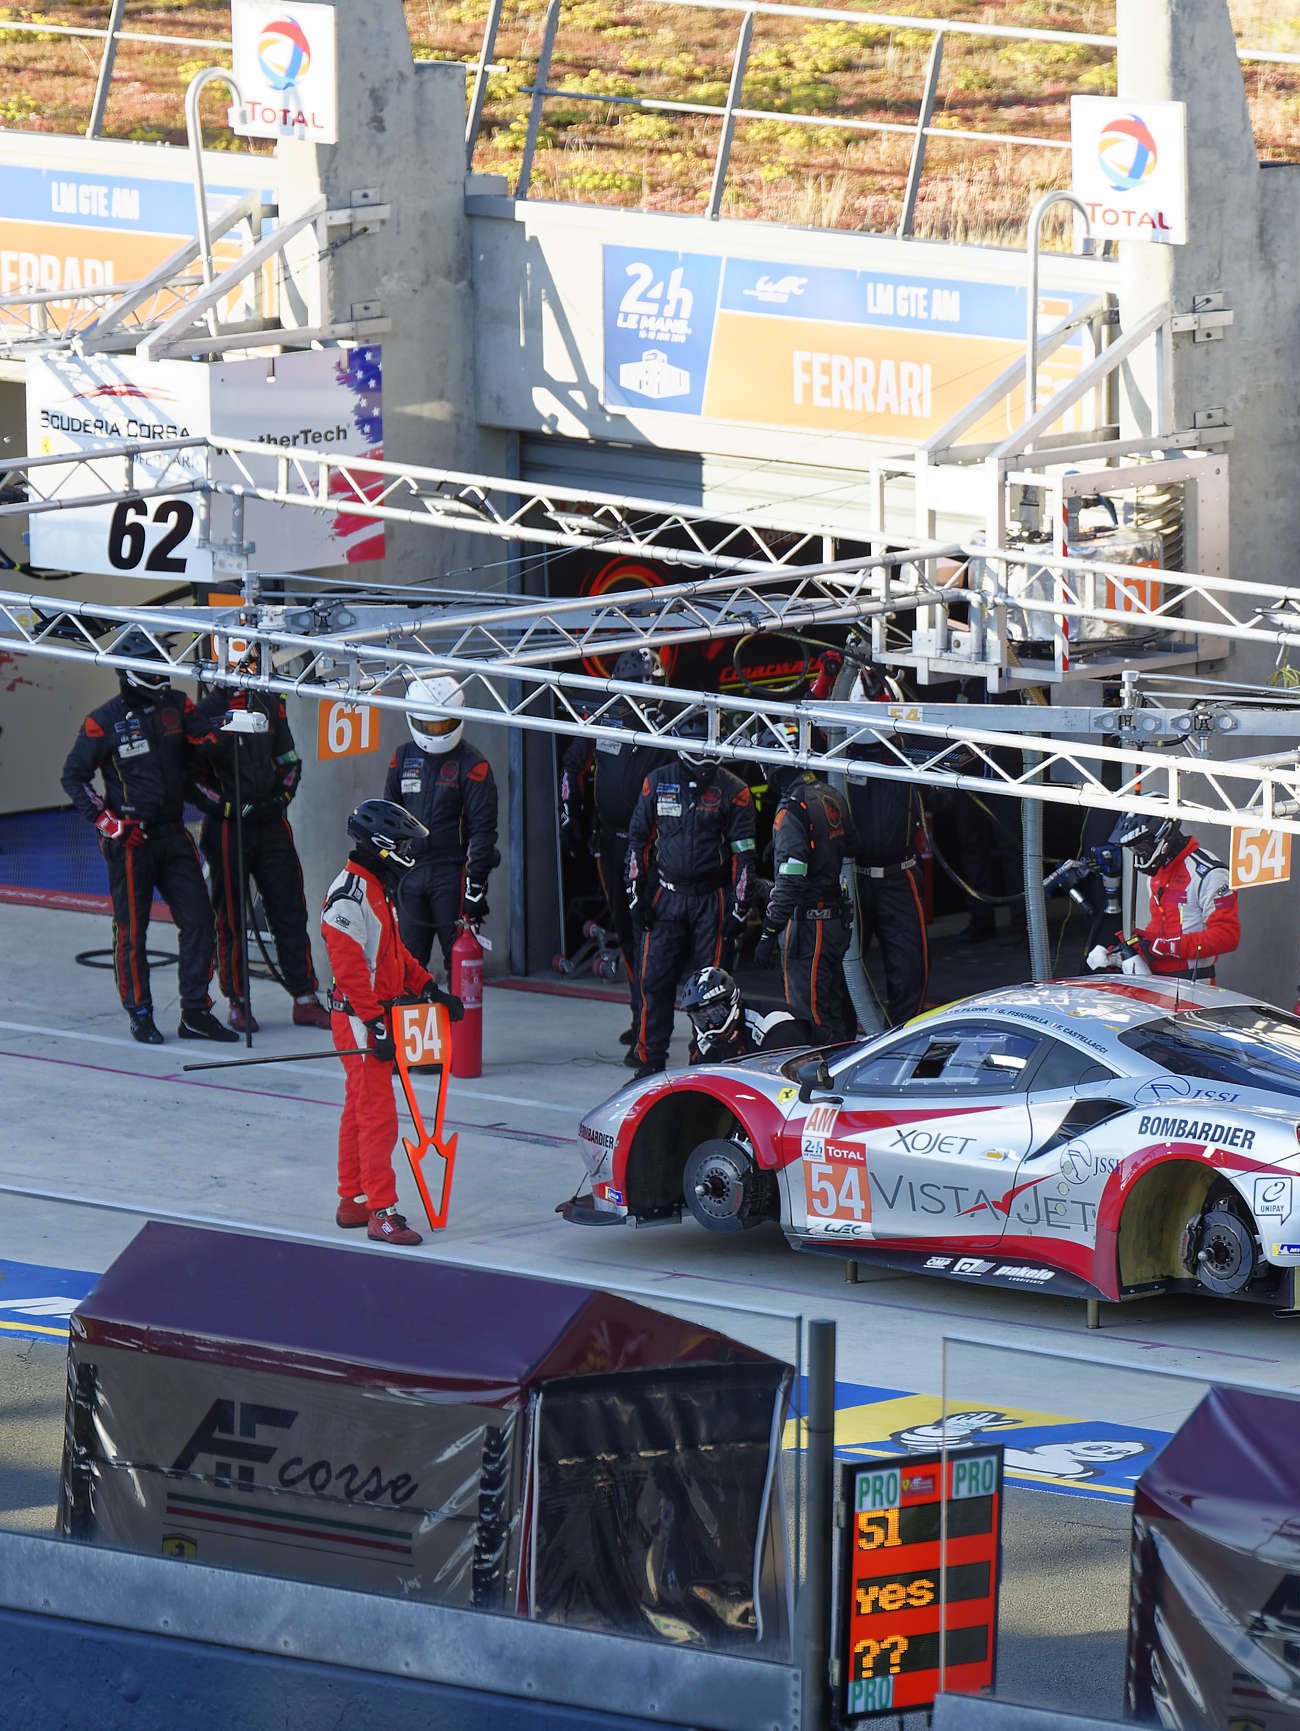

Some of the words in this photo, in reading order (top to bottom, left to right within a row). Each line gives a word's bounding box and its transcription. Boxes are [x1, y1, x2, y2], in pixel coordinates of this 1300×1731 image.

[244, 100, 324, 129] TOTAL
[1084, 202, 1173, 230] TOTAL
[867, 281, 894, 315] LM
[896, 284, 928, 320] GTE
[931, 288, 961, 322] AM
[793, 349, 932, 419] FERRARI
[40, 409, 121, 438] SCUDERIA
[126, 418, 191, 440] CORSA
[108, 499, 194, 573] 62
[327, 700, 370, 754] 61
[1120, 824, 1149, 844] BELL
[1236, 827, 1287, 883] 54
[702, 984, 727, 1000] BELL
[1007, 1010, 1049, 1026] FISICHELLA
[402, 1006, 442, 1063] 54
[1062, 1027, 1109, 1054] CASTELLACCI
[1192, 1088, 1241, 1104] JSSI
[804, 1106, 837, 1133] AM
[1138, 1115, 1256, 1150] BOMBARDIER
[826, 1145, 865, 1161] TOTAL
[889, 1129, 978, 1156] XOJET
[1093, 1156, 1121, 1177] JSSI
[811, 1163, 866, 1220] 54
[1260, 1205, 1284, 1213] UNIPAY
[823, 1223, 862, 1236] WEC
[277, 1456, 420, 1506] corse
[857, 1471, 899, 1511] PRO
[953, 1458, 995, 1498] PRO
[857, 1508, 903, 1551] 51
[854, 1634, 909, 1679] ??
[851, 1675, 894, 1715] PRO
